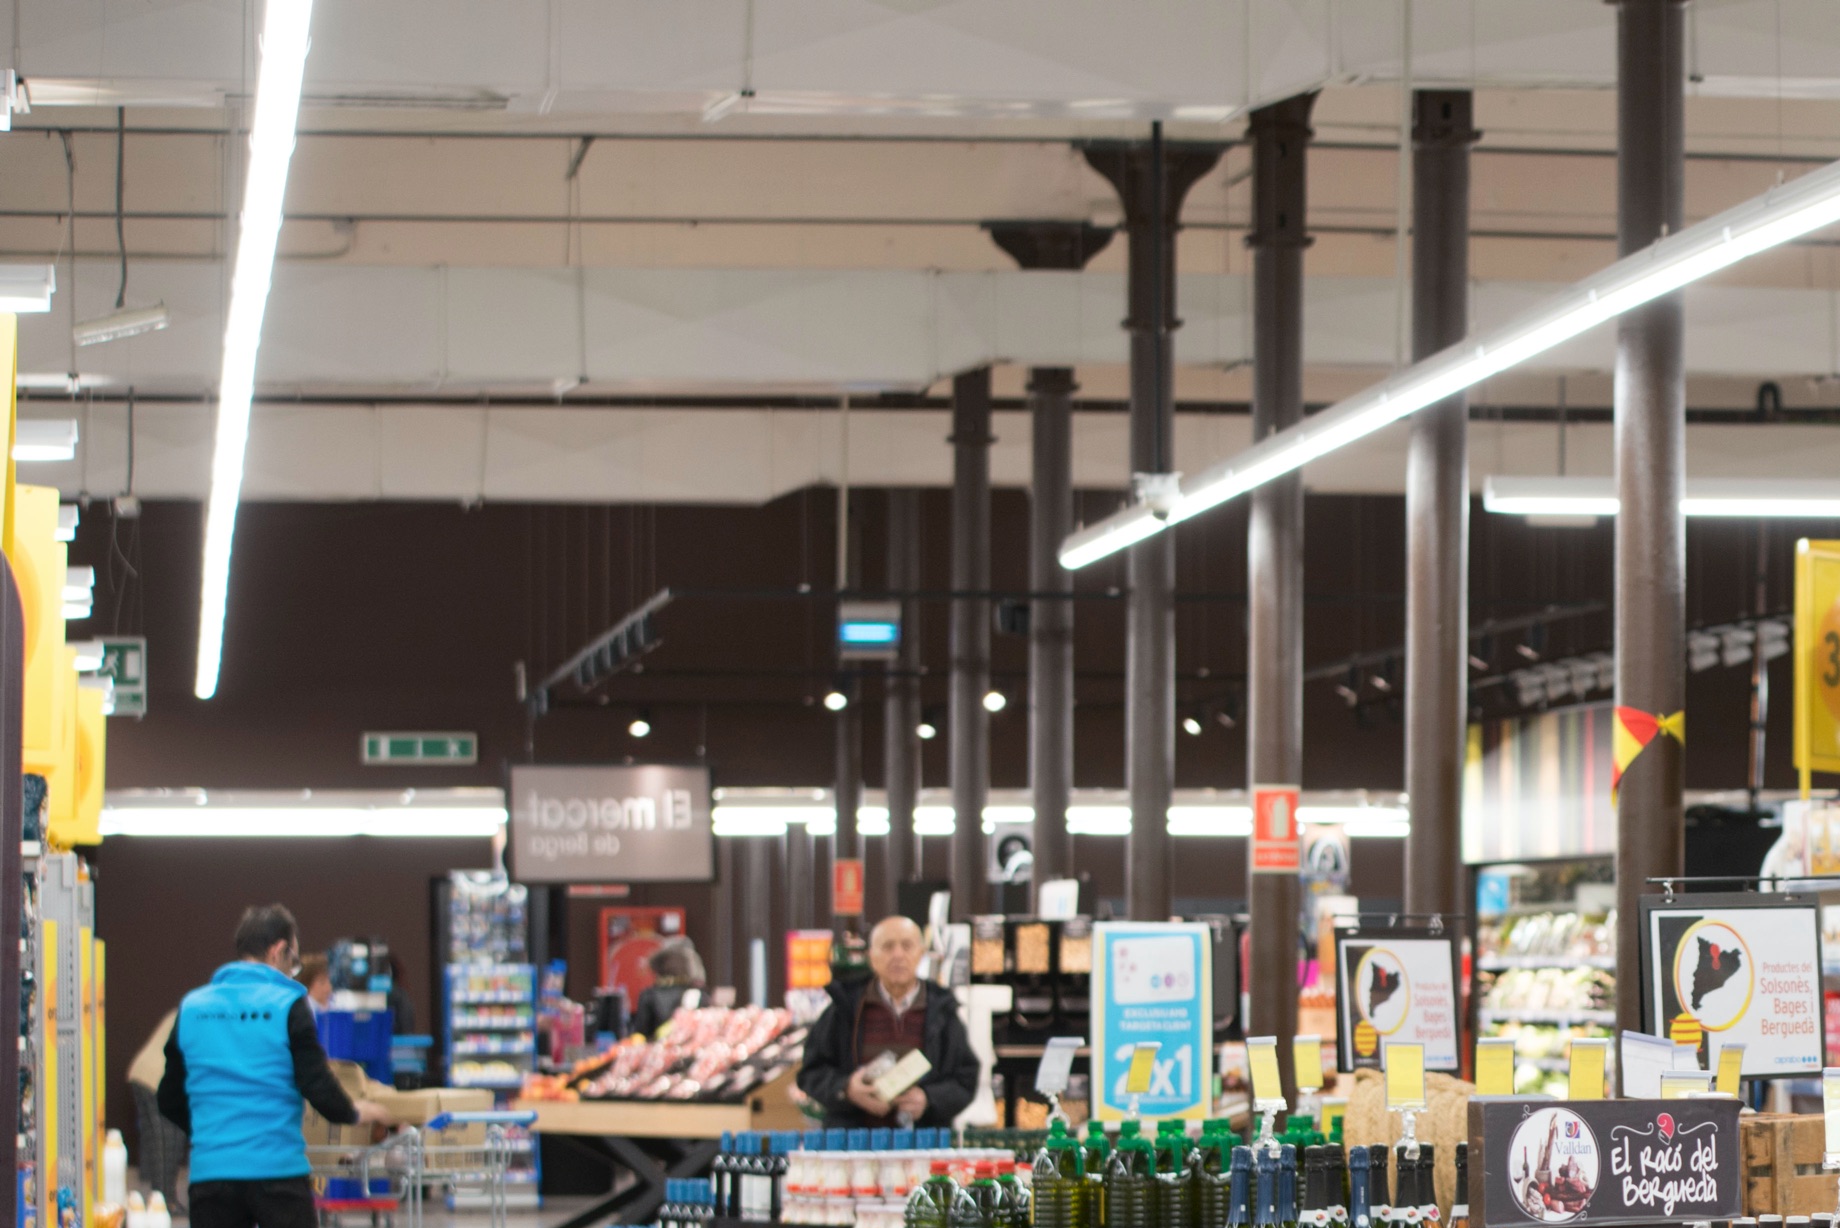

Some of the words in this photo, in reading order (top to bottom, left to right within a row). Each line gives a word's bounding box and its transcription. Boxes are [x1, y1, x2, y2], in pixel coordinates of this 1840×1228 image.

[1774, 998, 1808, 1017] Bages
[1761, 1017, 1815, 1039] Berguedà
[1555, 1142, 1592, 1155] Valldan
[1611, 1136, 1632, 1175] El
[1690, 1133, 1718, 1172] del
